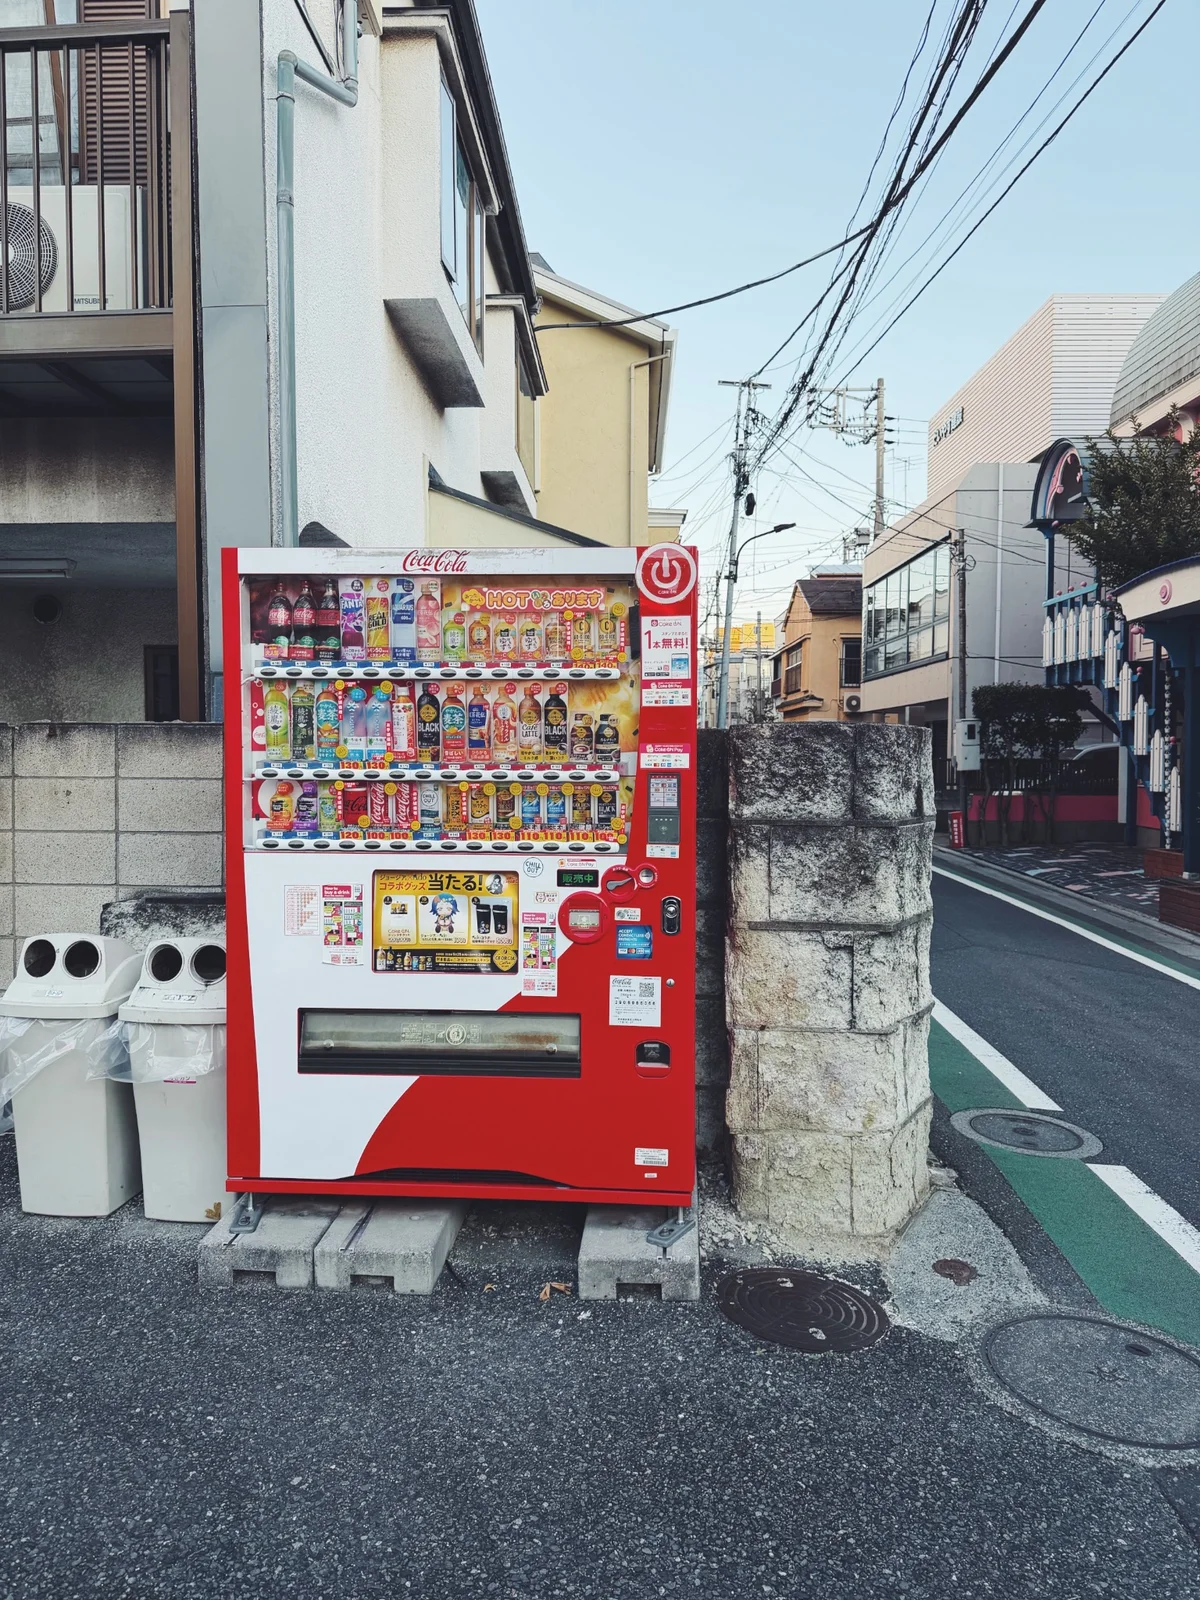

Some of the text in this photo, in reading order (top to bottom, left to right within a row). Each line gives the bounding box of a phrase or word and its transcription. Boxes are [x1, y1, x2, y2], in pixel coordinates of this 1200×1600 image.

[402, 549, 470, 572] Coca-Cola
[341, 599, 363, 610] FANTA
[487, 591, 530, 608] HOT
[552, 591, 601, 607] あります
[317, 709, 338, 721] 麦茶
[443, 713, 463, 725] 麦茶
[418, 722, 439, 732] BLACK
[544, 725, 566, 735] BLACK
[521, 730, 538, 738] LATTE
[525, 860, 541, 869] CHILL
[526, 866, 539, 874] OUT
[428, 872, 483, 892] 当たる!
[562, 872, 594, 884] 販売中
[379, 881, 427, 891] コラボグッズ
